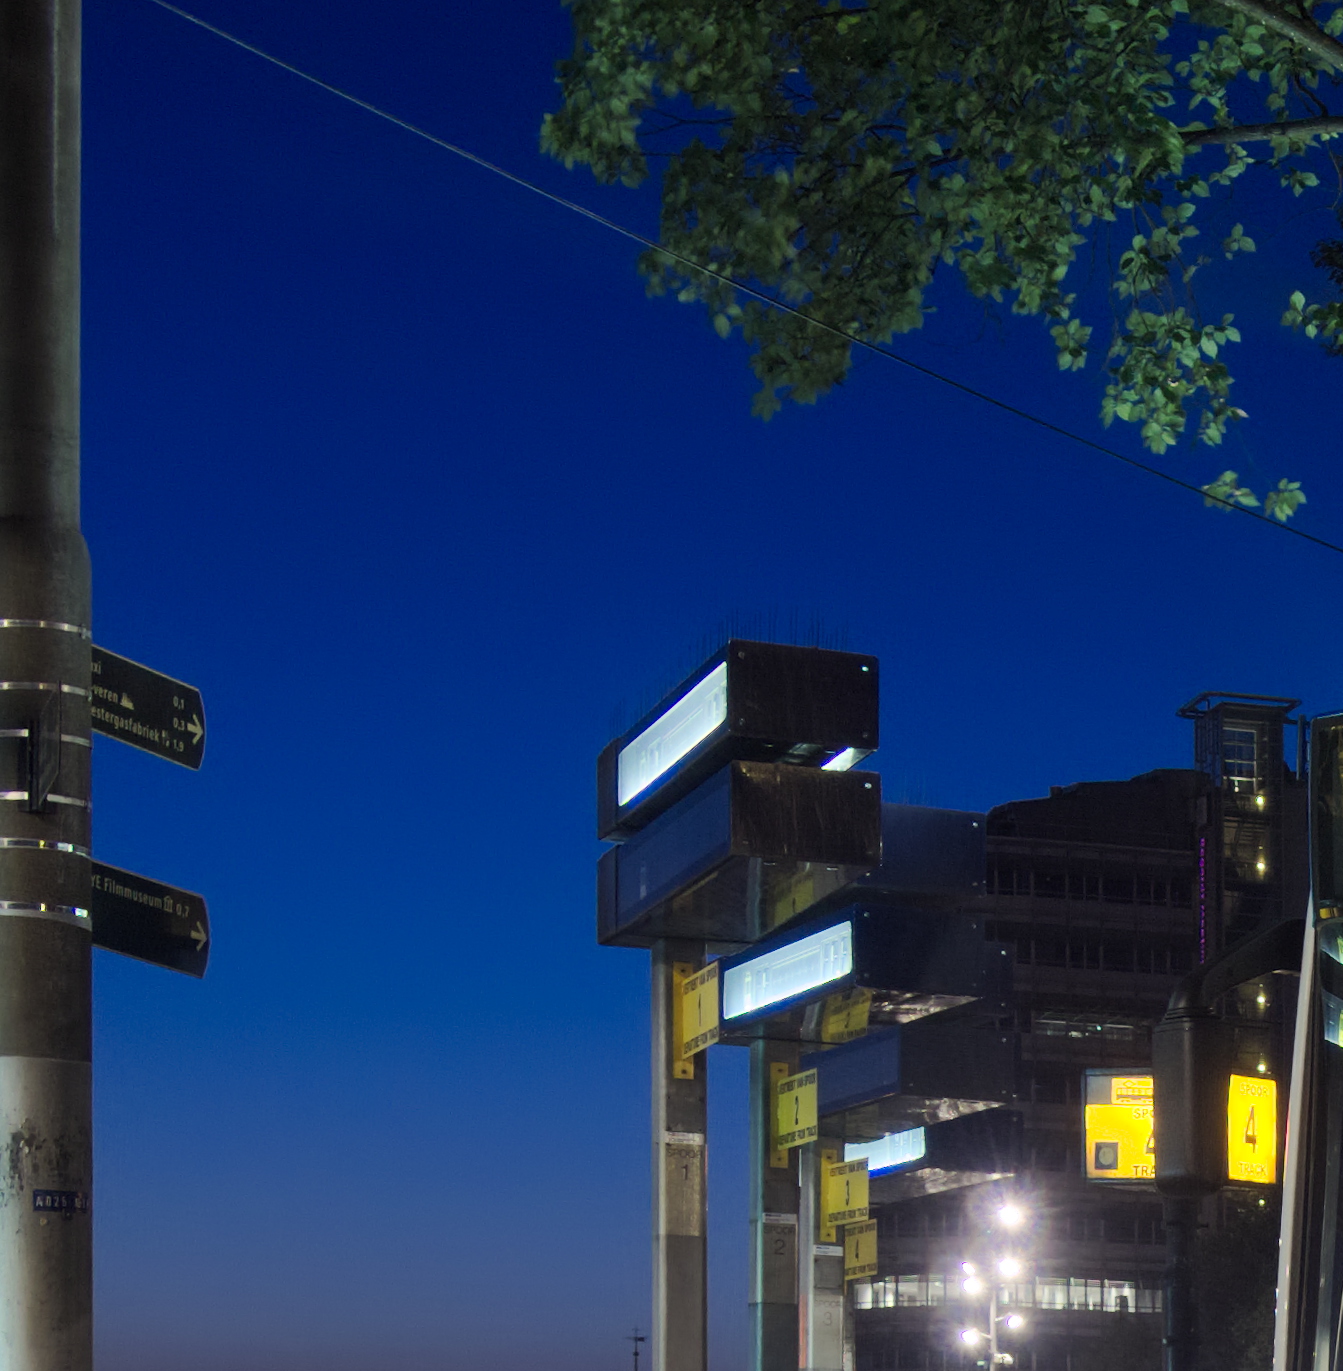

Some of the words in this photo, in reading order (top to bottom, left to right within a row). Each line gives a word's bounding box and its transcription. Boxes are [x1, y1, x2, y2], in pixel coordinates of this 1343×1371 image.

[91, 706, 160, 742] estergasfabriek
[91, 875, 102, 890] YE
[104, 877, 162, 909] Filmmuseum
[1239, 1083, 1268, 1097] SPOOR
[795, 1095, 799, 1125] 2
[1245, 1104, 1257, 1154] 4
[681, 1164, 689, 1180] 1
[1133, 1165, 1155, 1176] TRA
[1239, 1163, 1267, 1176] TRACK
[845, 1179, 850, 1206] 3
[774, 1239, 786, 1256] 2
